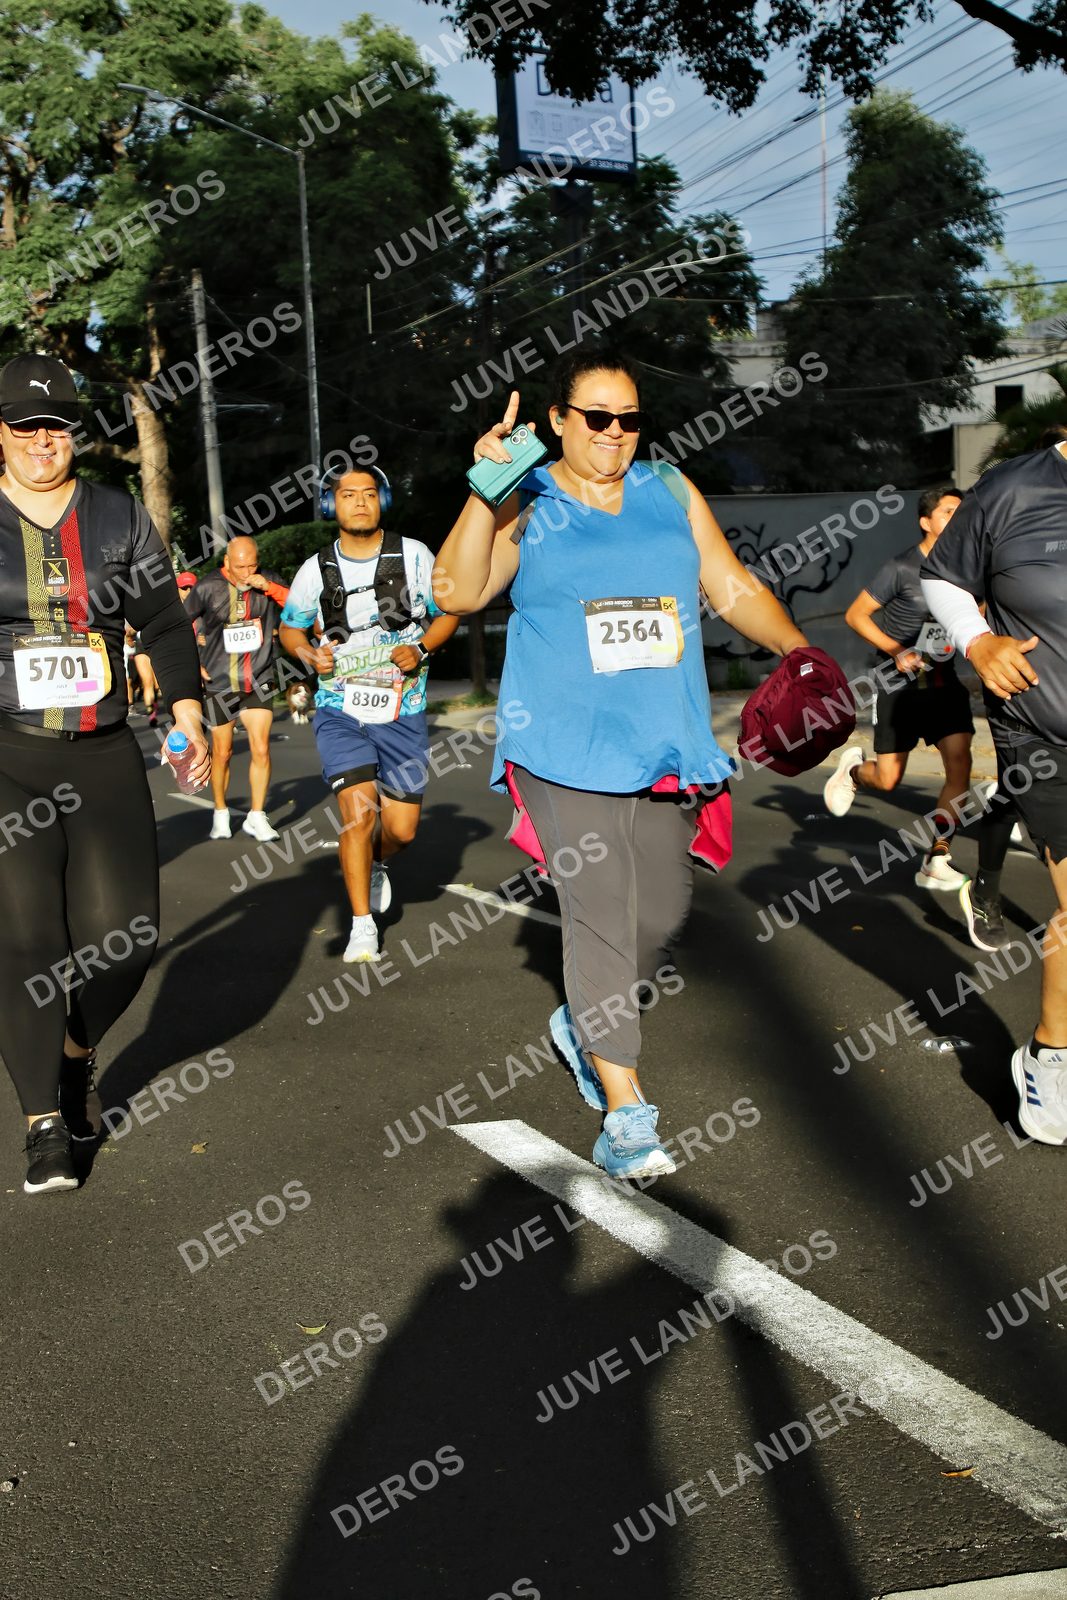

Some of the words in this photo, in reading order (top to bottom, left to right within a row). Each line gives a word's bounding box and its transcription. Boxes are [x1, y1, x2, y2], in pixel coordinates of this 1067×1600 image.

[228, 630, 257, 642] 10263
[600, 619, 663, 645] 2564
[30, 656, 88, 682] 5701
[352, 691, 389, 709] 8309
